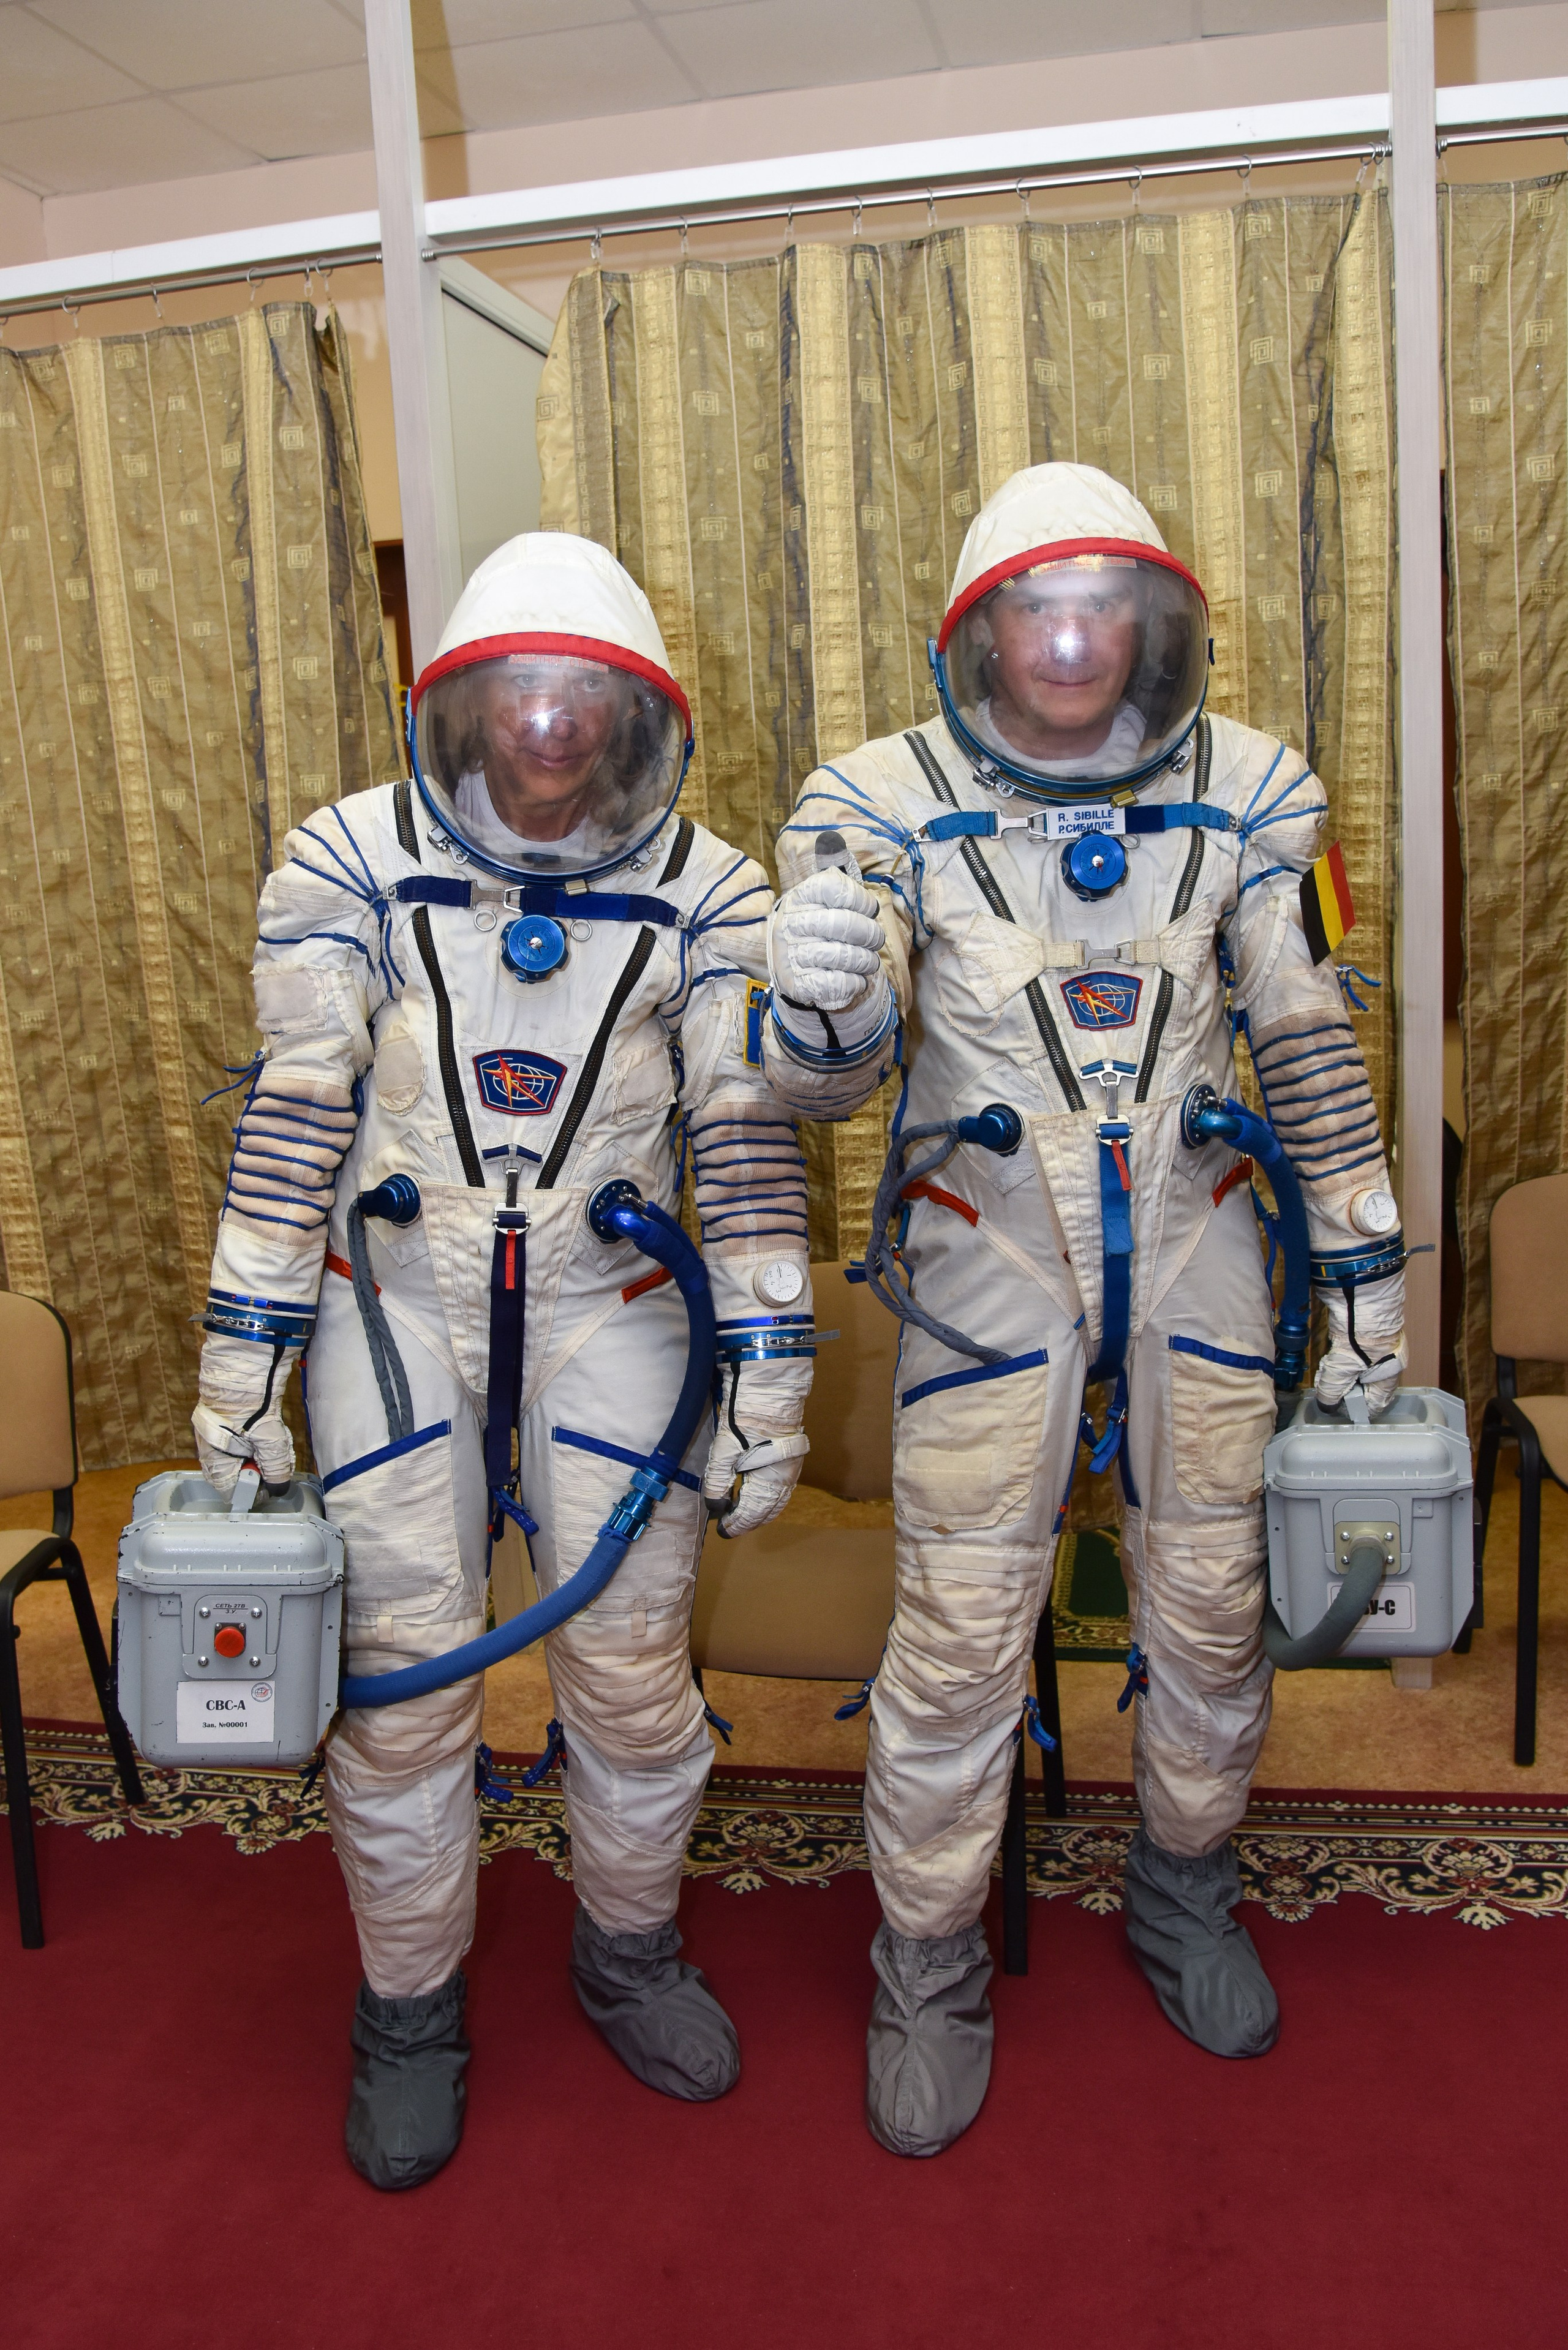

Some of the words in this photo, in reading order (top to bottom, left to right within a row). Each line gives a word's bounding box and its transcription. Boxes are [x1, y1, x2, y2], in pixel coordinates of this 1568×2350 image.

[1058, 813, 1069, 822] R.
[1074, 809, 1114, 821] SIBILLE
[1058, 821, 1115, 834] Р.СИБИЛЛЕ
[206, 1700, 246, 1711] СВС-А
